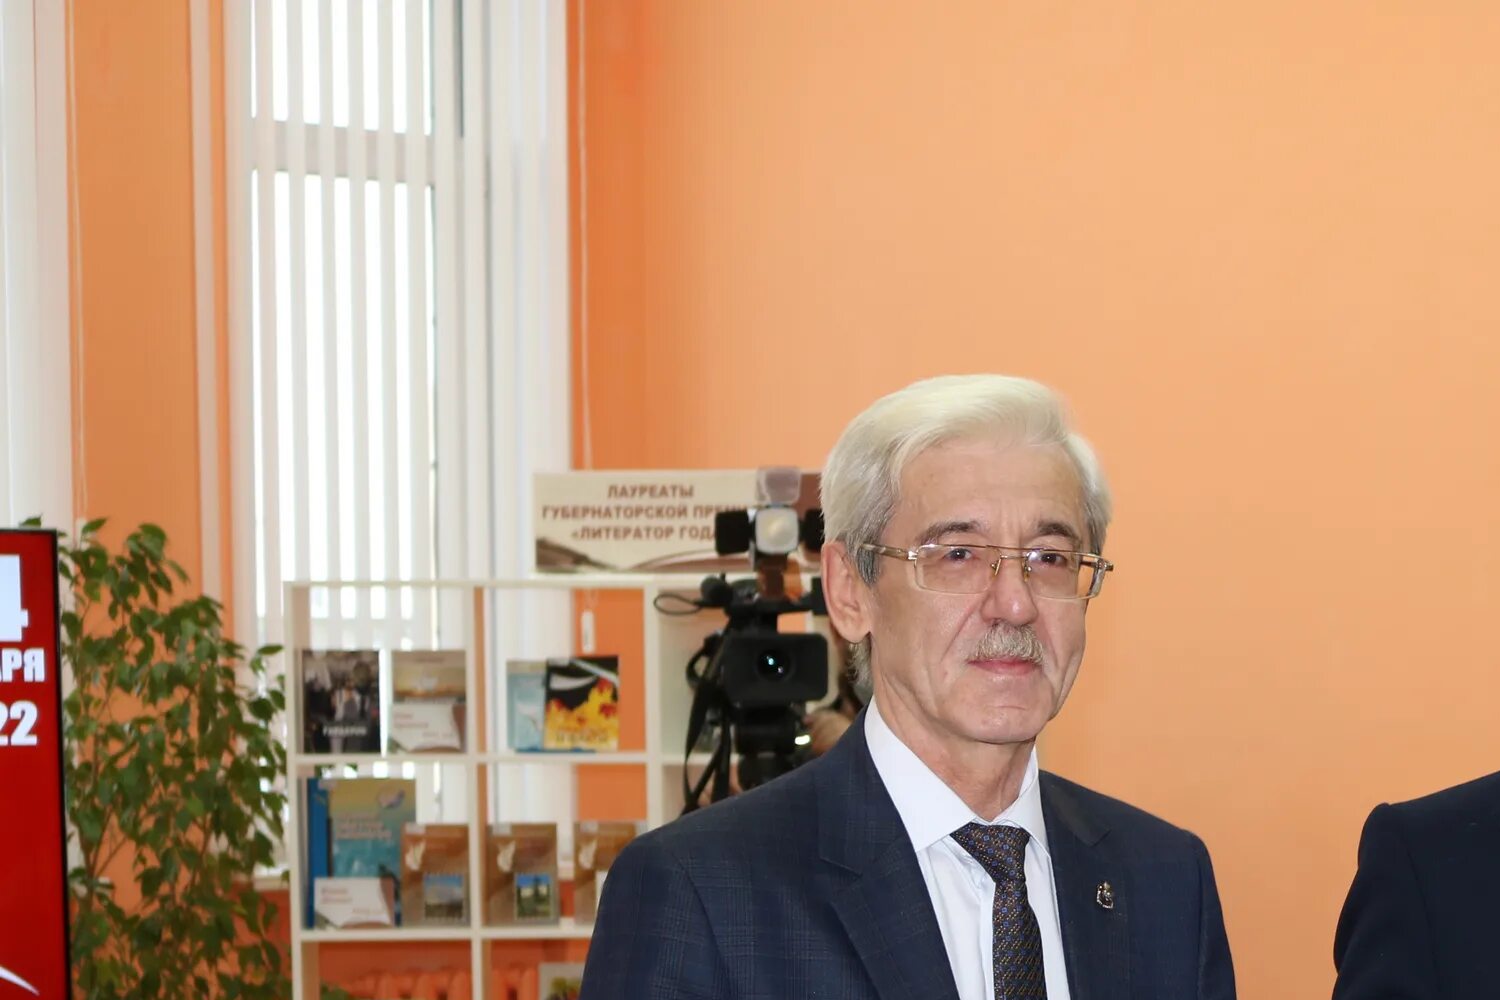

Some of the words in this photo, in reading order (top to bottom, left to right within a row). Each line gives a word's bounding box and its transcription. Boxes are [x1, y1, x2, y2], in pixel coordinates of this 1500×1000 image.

[608, 484, 693, 499] ЛАУРЕАТЫ
[542, 503, 688, 520] ГУБЕРНАТОРСКОЙ
[571, 525, 674, 541] «ЛИТЕРАТОР
